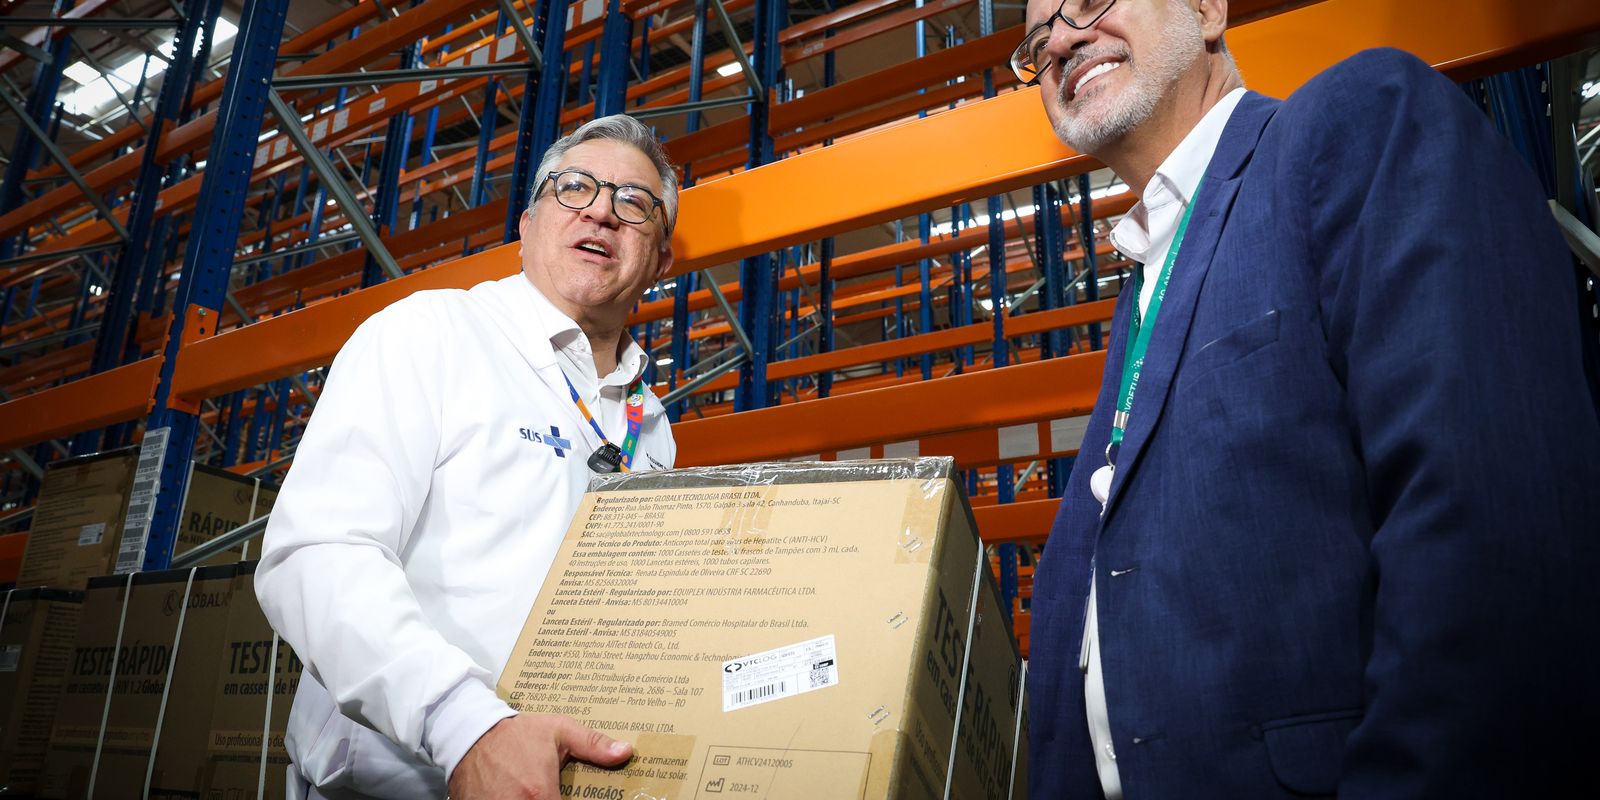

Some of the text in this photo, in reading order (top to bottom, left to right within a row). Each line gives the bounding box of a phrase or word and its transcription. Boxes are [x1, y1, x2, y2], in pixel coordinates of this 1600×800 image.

[519, 427, 542, 443] SUS
[597, 495, 638, 505] Regularizado
[683, 493, 720, 501] TECNOLOGIA
[720, 492, 741, 500] BRASIL
[593, 504, 624, 513] Endereço:
[676, 502, 692, 510] Pinto,
[696, 501, 711, 510] 1570,
[714, 500, 736, 510] Galpão
[663, 538, 694, 547] Anticorpo
[753, 537, 781, 546] Hepatite
[788, 536, 828, 545] (ANTI-HCV)
[588, 550, 626, 559] embalagem
[774, 547, 803, 556] Tampões
[675, 558, 700, 566] estéreis,
[740, 557, 769, 566] capilares.
[564, 569, 604, 579] Responsável
[609, 588, 655, 598] Regularizado
[656, 590, 672, 598] por:
[672, 588, 704, 598] EQUIPLEX
[706, 586, 742, 595] INDÚSTRIA
[743, 586, 797, 595] FARMACÊUTICA
[570, 618, 592, 626] Estéril
[597, 618, 644, 628] Regularizado
[690, 619, 720, 627] Comércio
[722, 620, 758, 629] Hospitalar
[791, 620, 808, 628] Ltda.
[566, 628, 588, 636] Estéril
[533, 639, 572, 647] Fabricante:
[628, 641, 652, 649] Biotech
[654, 642, 666, 651] Co.,
[230, 640, 284, 674] TESTE
[528, 648, 562, 659] Endereço:
[563, 649, 580, 659] #550,
[582, 650, 602, 658] Yinhai
[603, 651, 624, 660] Street,
[625, 651, 660, 662] Hangzhou
[660, 652, 692, 661] Economic
[558, 660, 582, 670] 310018,
[519, 670, 556, 681] Importado
[557, 674, 572, 682] por:
[575, 672, 590, 680] Daas
[641, 674, 673, 683] Comércio
[674, 675, 690, 683] Ltda
[514, 680, 704, 696] Endereço: AV. Governador Jorge Teixeira, 2686 Sala 107
[510, 691, 686, 707] CEP: 76820-892 Bairro Embratel Porto Velho RO
[587, 720, 629, 731] TECNOLOGIA
[630, 722, 654, 732] BRASIL
[648, 757, 687, 767] armazenar
[645, 769, 688, 780] da luz solar.
[574, 785, 581, 796] A
[582, 784, 625, 800] ÓRGÃOS
[729, 783, 759, 793] 2024-12
